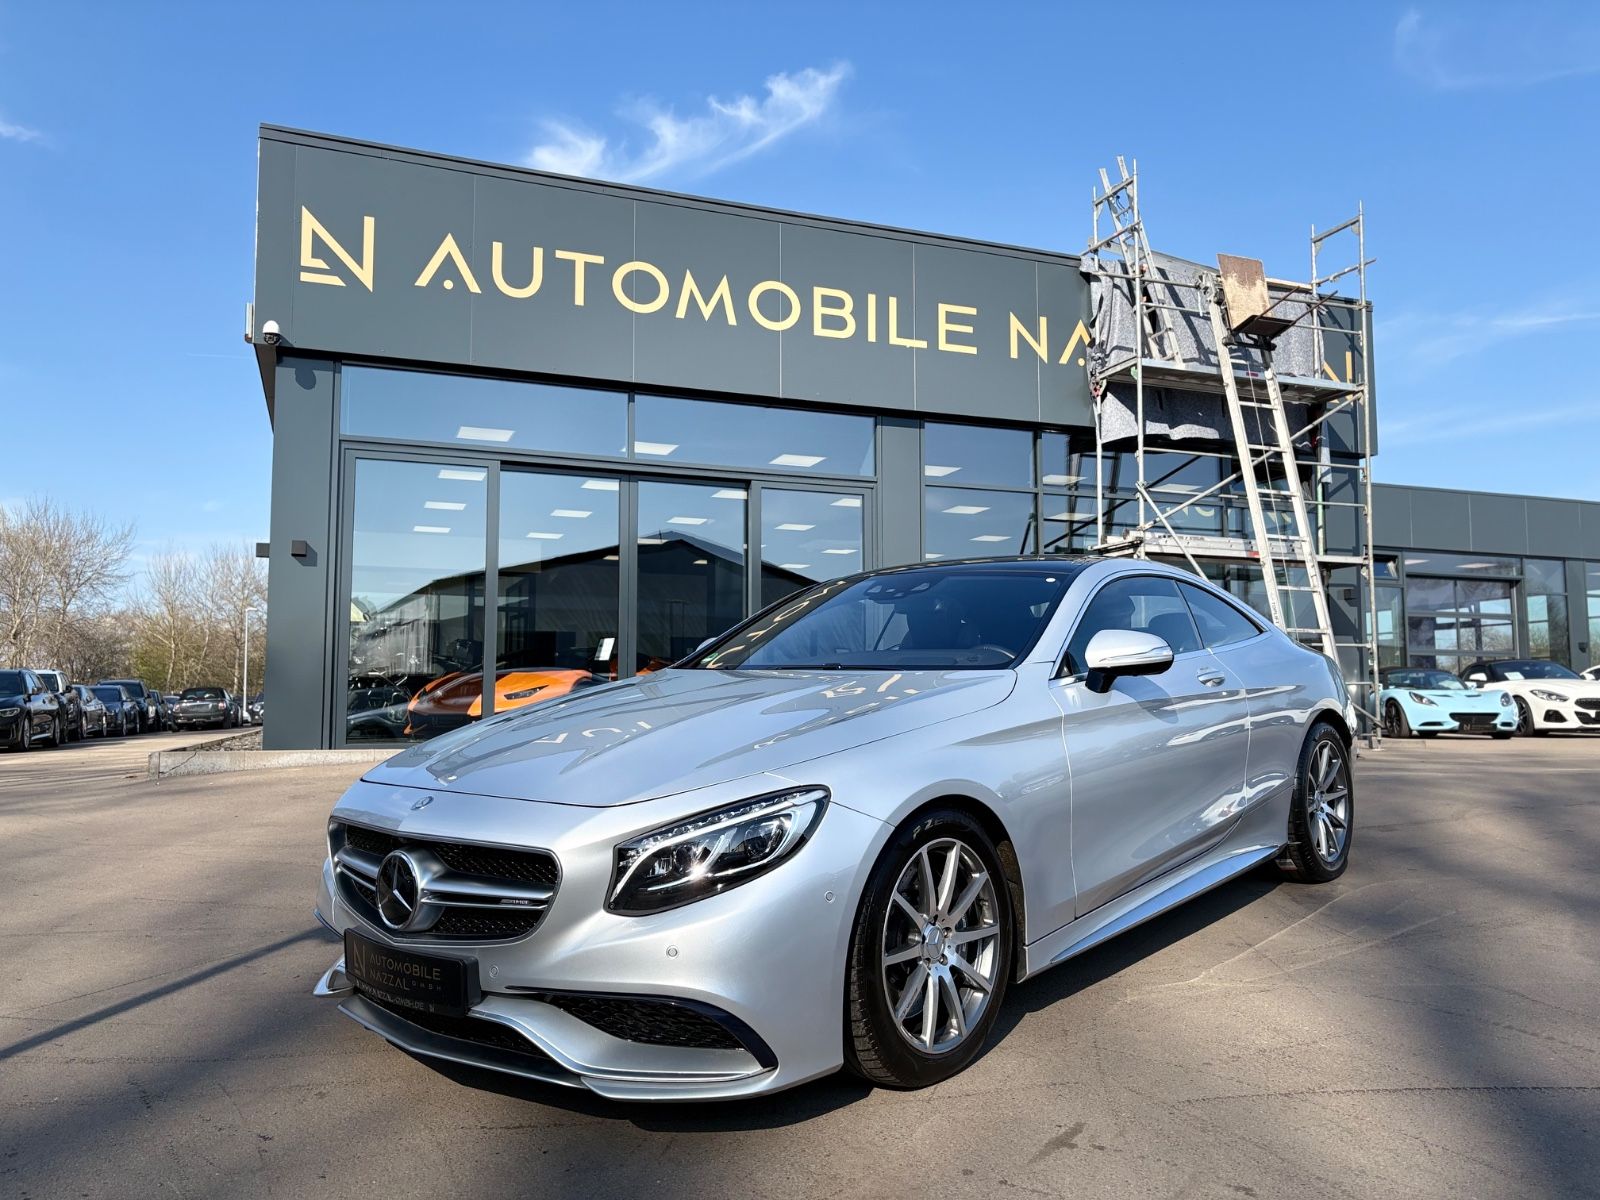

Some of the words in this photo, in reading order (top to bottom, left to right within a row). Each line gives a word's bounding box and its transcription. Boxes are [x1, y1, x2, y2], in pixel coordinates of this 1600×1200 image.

[414, 233, 978, 355] AUTOMOBILE
[369, 953, 441, 981] AUTOMOBILE
[370, 969, 410, 990] NAZZAL
